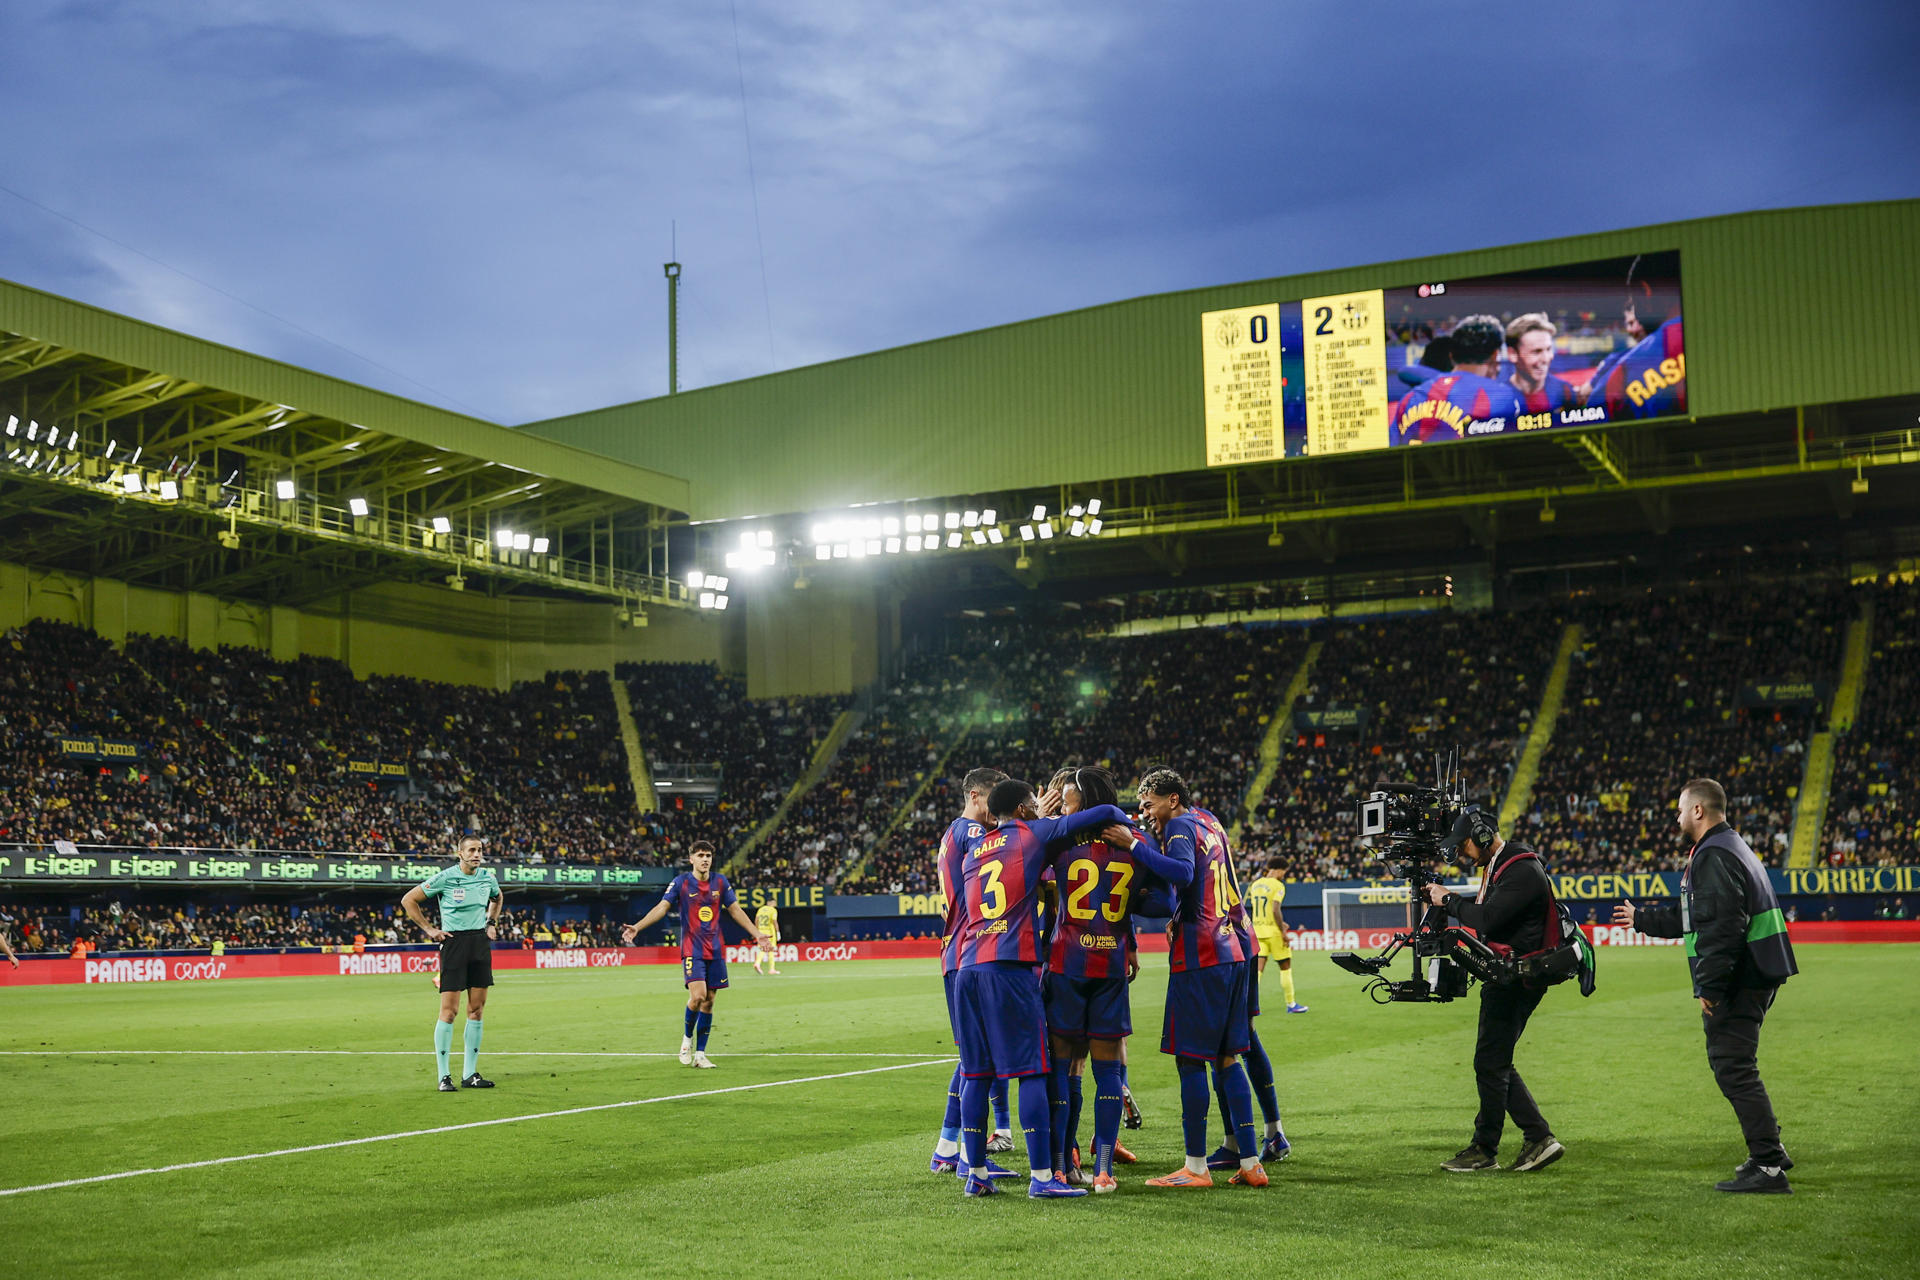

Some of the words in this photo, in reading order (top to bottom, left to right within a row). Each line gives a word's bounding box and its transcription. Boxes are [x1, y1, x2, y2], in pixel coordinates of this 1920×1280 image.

[1430, 283, 1445, 295] LG
[1251, 315, 1267, 344] 0
[1315, 306, 1333, 336] 2
[1560, 407, 1605, 424] LALIGA
[974, 835, 1008, 858] BALDE
[25, 854, 97, 875] sicer
[110, 855, 177, 876] sicer
[189, 857, 251, 878] sicer
[262, 859, 319, 879] sicer
[329, 860, 382, 880] sicer
[504, 864, 548, 882] sicer
[555, 865, 597, 883] sicer
[603, 866, 643, 883] sicer
[978, 860, 1007, 920] 3
[1068, 859, 1134, 922] 23
[1358, 878, 1411, 904] altad
[1783, 867, 1920, 894] TORRECID
[735, 886, 825, 909] ESTILE
[899, 895, 943, 915] PAM
[1254, 896, 1268, 918] 17
[759, 915, 769, 926] 22
[1286, 931, 1360, 950] AMESA
[85, 958, 166, 983] PAMESA
[339, 953, 402, 975] PAMESA
[535, 950, 587, 968] PAMESA
[685, 957, 693, 969] 5
